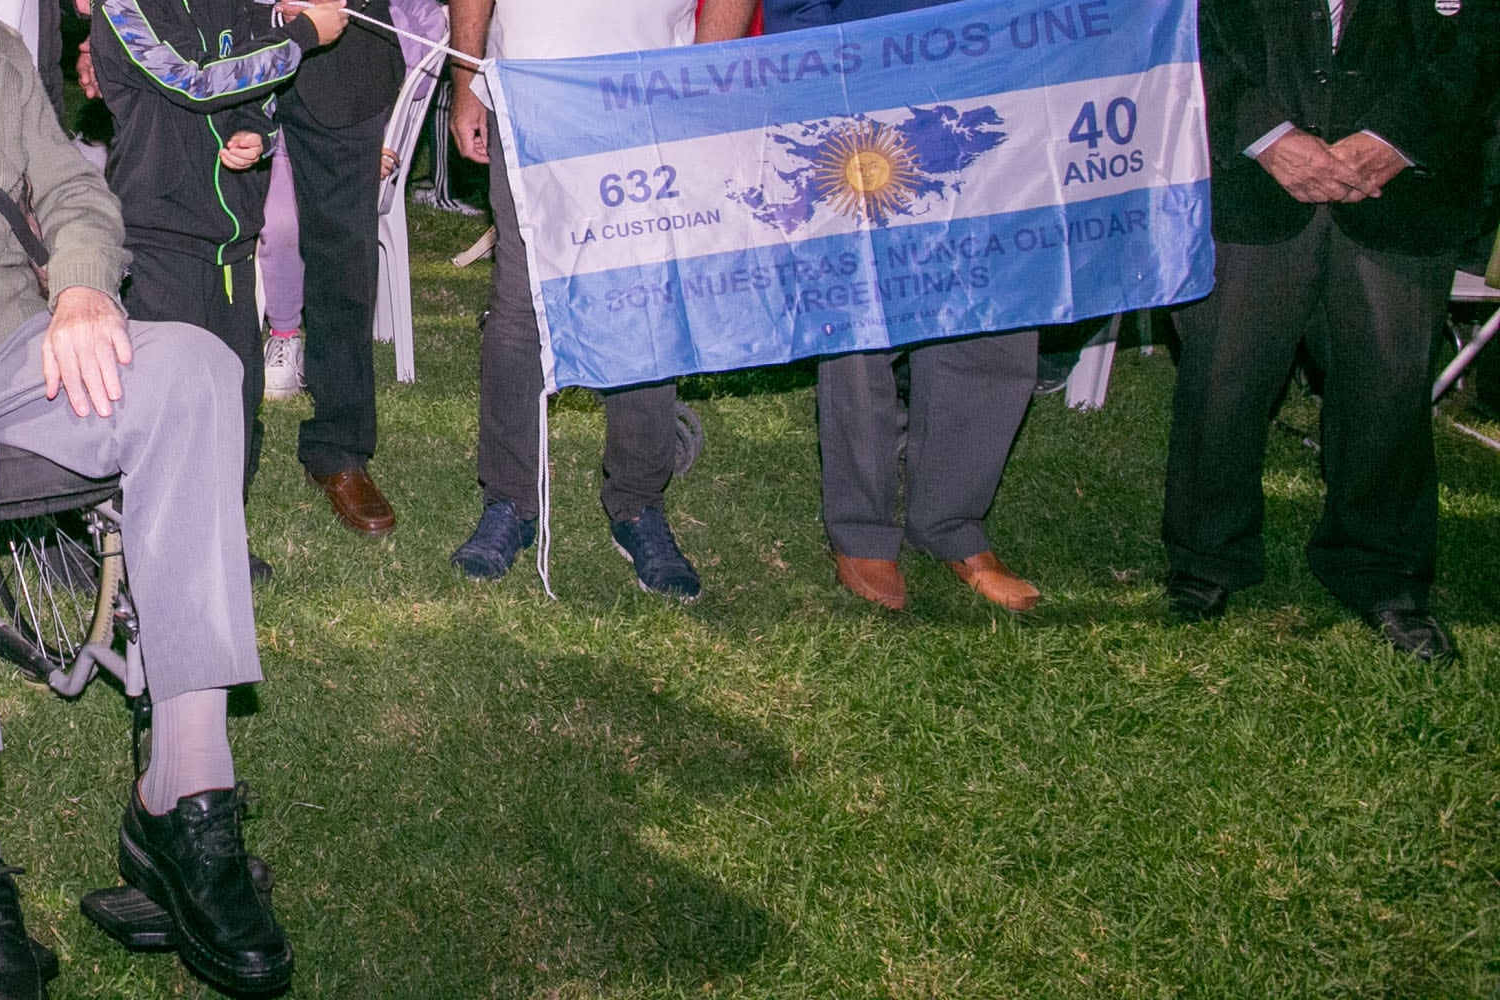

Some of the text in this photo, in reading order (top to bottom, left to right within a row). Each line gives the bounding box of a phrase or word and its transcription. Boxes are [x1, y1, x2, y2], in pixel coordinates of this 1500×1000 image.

[598, 0, 1113, 112] MALVINAS NOS UNE
[1067, 95, 1138, 150] 40
[598, 163, 681, 208] 632
[1062, 146, 1145, 187] AÑOS
[570, 207, 722, 246] LA CUSTODIAN
[604, 280, 673, 313] SON
[684, 250, 859, 300] NUESTRAS
[887, 235, 1006, 269] NUNCA
[1013, 209, 1149, 252] OLVIDAR
[781, 265, 990, 318] ARGENTINAS
